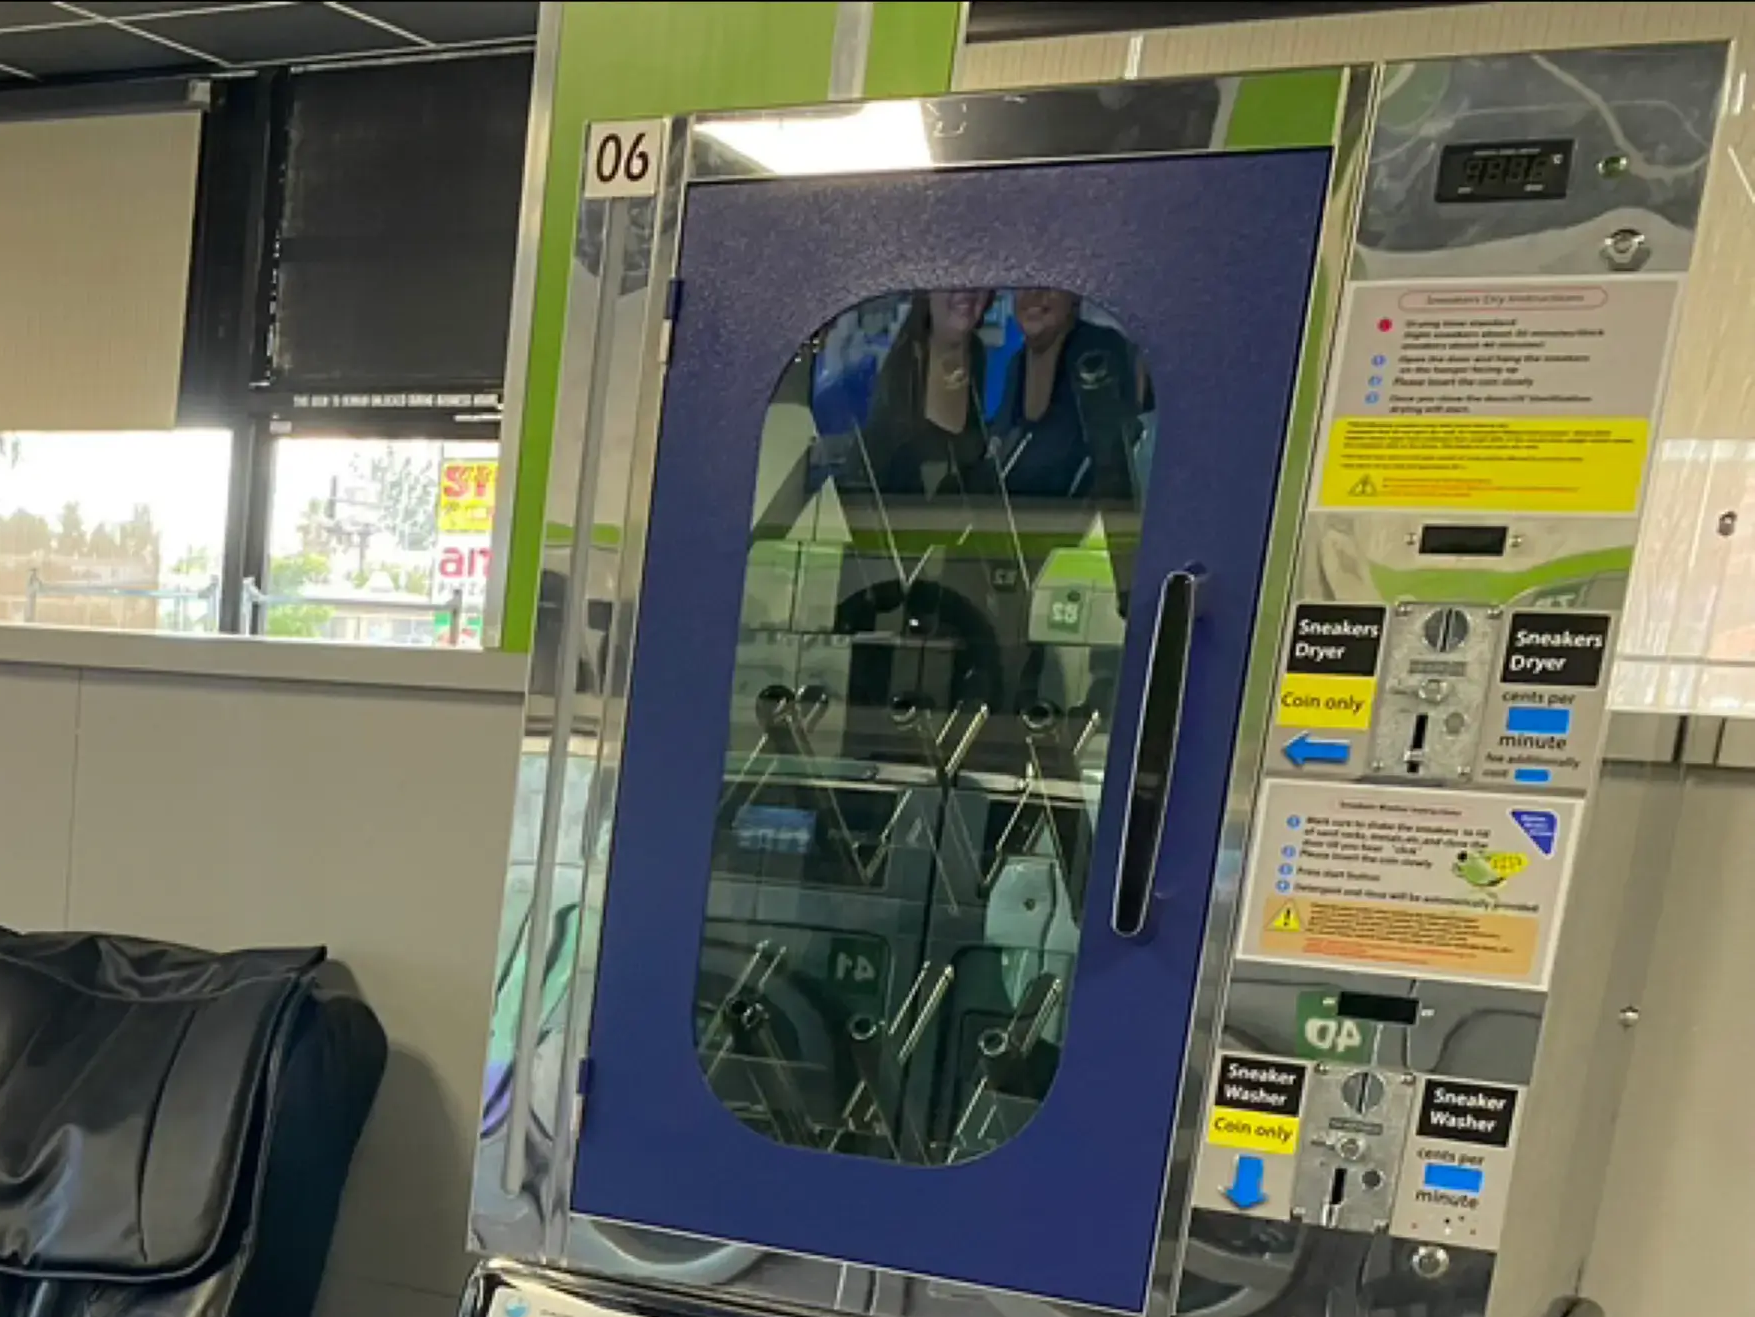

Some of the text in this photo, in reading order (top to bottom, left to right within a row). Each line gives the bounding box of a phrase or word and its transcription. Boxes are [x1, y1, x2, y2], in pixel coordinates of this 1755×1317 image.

[596, 132, 649, 183] 06
[1298, 617, 1381, 639] Sneakers
[1513, 628, 1604, 650] Sneakers
[1294, 641, 1346, 663] Dryer
[1508, 654, 1568, 675] Dryer
[1280, 690, 1367, 715] Coin only
[1501, 690, 1577, 707] cents per
[1498, 734, 1568, 751] minute
[1226, 1062, 1298, 1086] Sneaker
[1223, 1084, 1289, 1107] Washer
[1432, 1086, 1508, 1111] Sneaker
[1213, 1116, 1294, 1143] Coin only
[1429, 1111, 1498, 1133] Washer
[1416, 1147, 1486, 1167] cents per
[1415, 1189, 1481, 1210] minute
